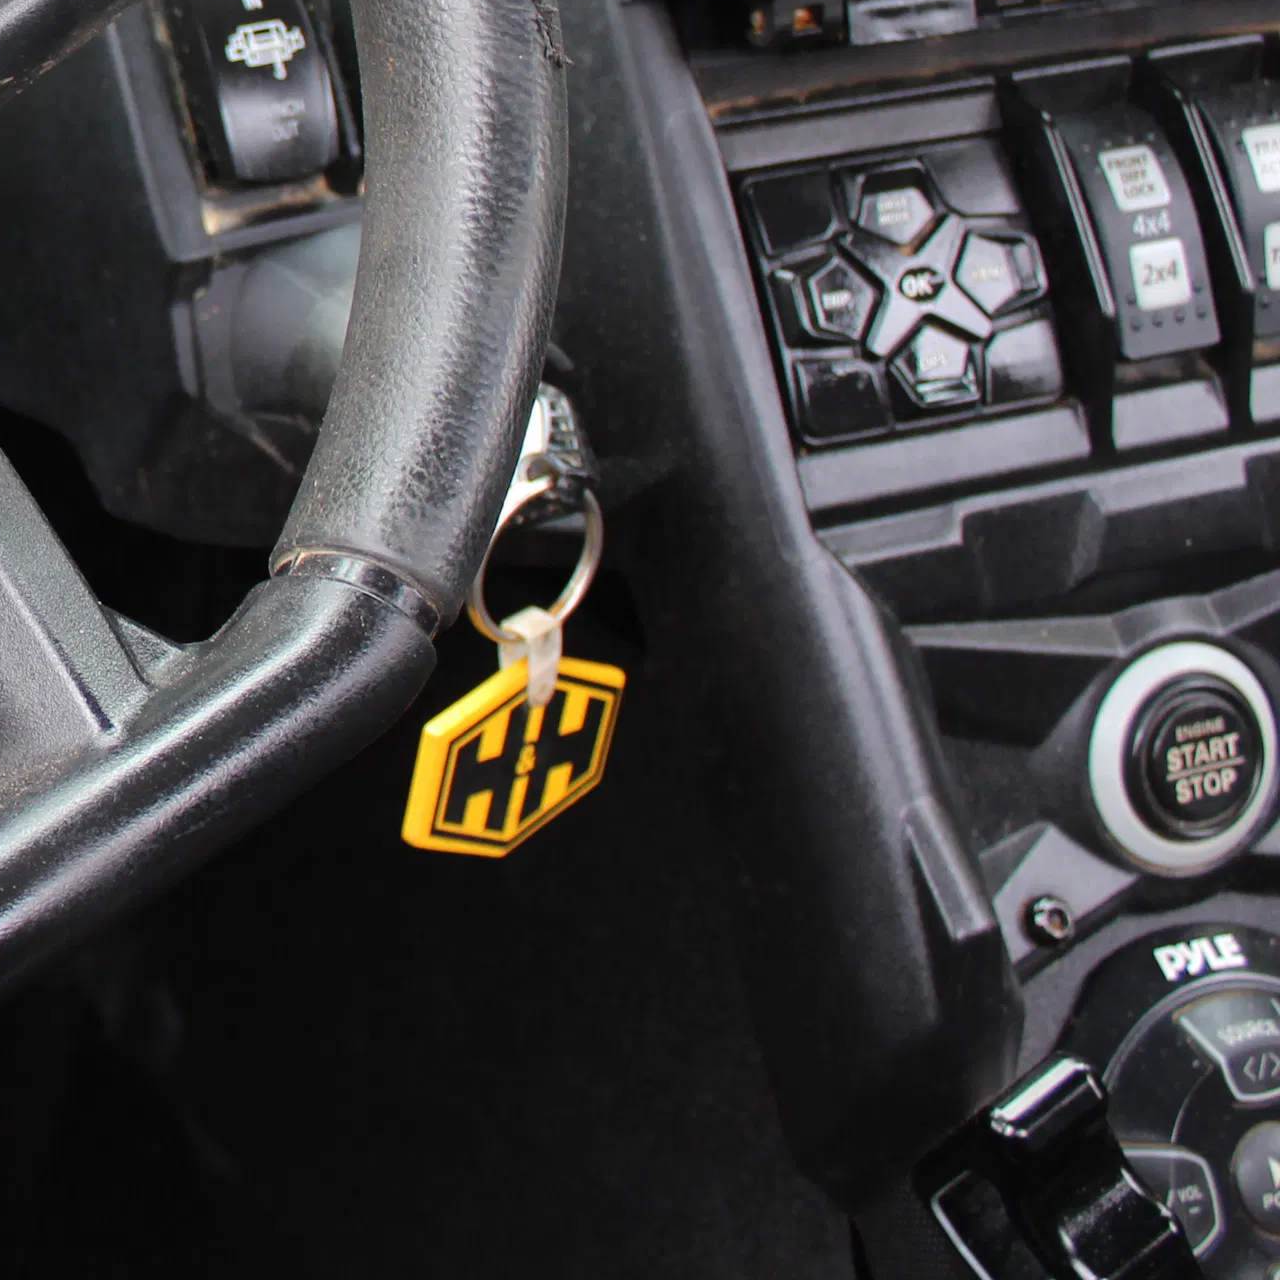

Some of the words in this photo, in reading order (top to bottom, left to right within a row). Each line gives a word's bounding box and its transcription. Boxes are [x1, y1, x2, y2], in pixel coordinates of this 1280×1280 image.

[1132, 208, 1171, 237] 4x4
[900, 272, 933, 298] OK
[1141, 259, 1179, 286] 2x4
[1166, 731, 1240, 773] START
[1175, 767, 1238, 805] STOP
[1153, 932, 1249, 983] PYLE
